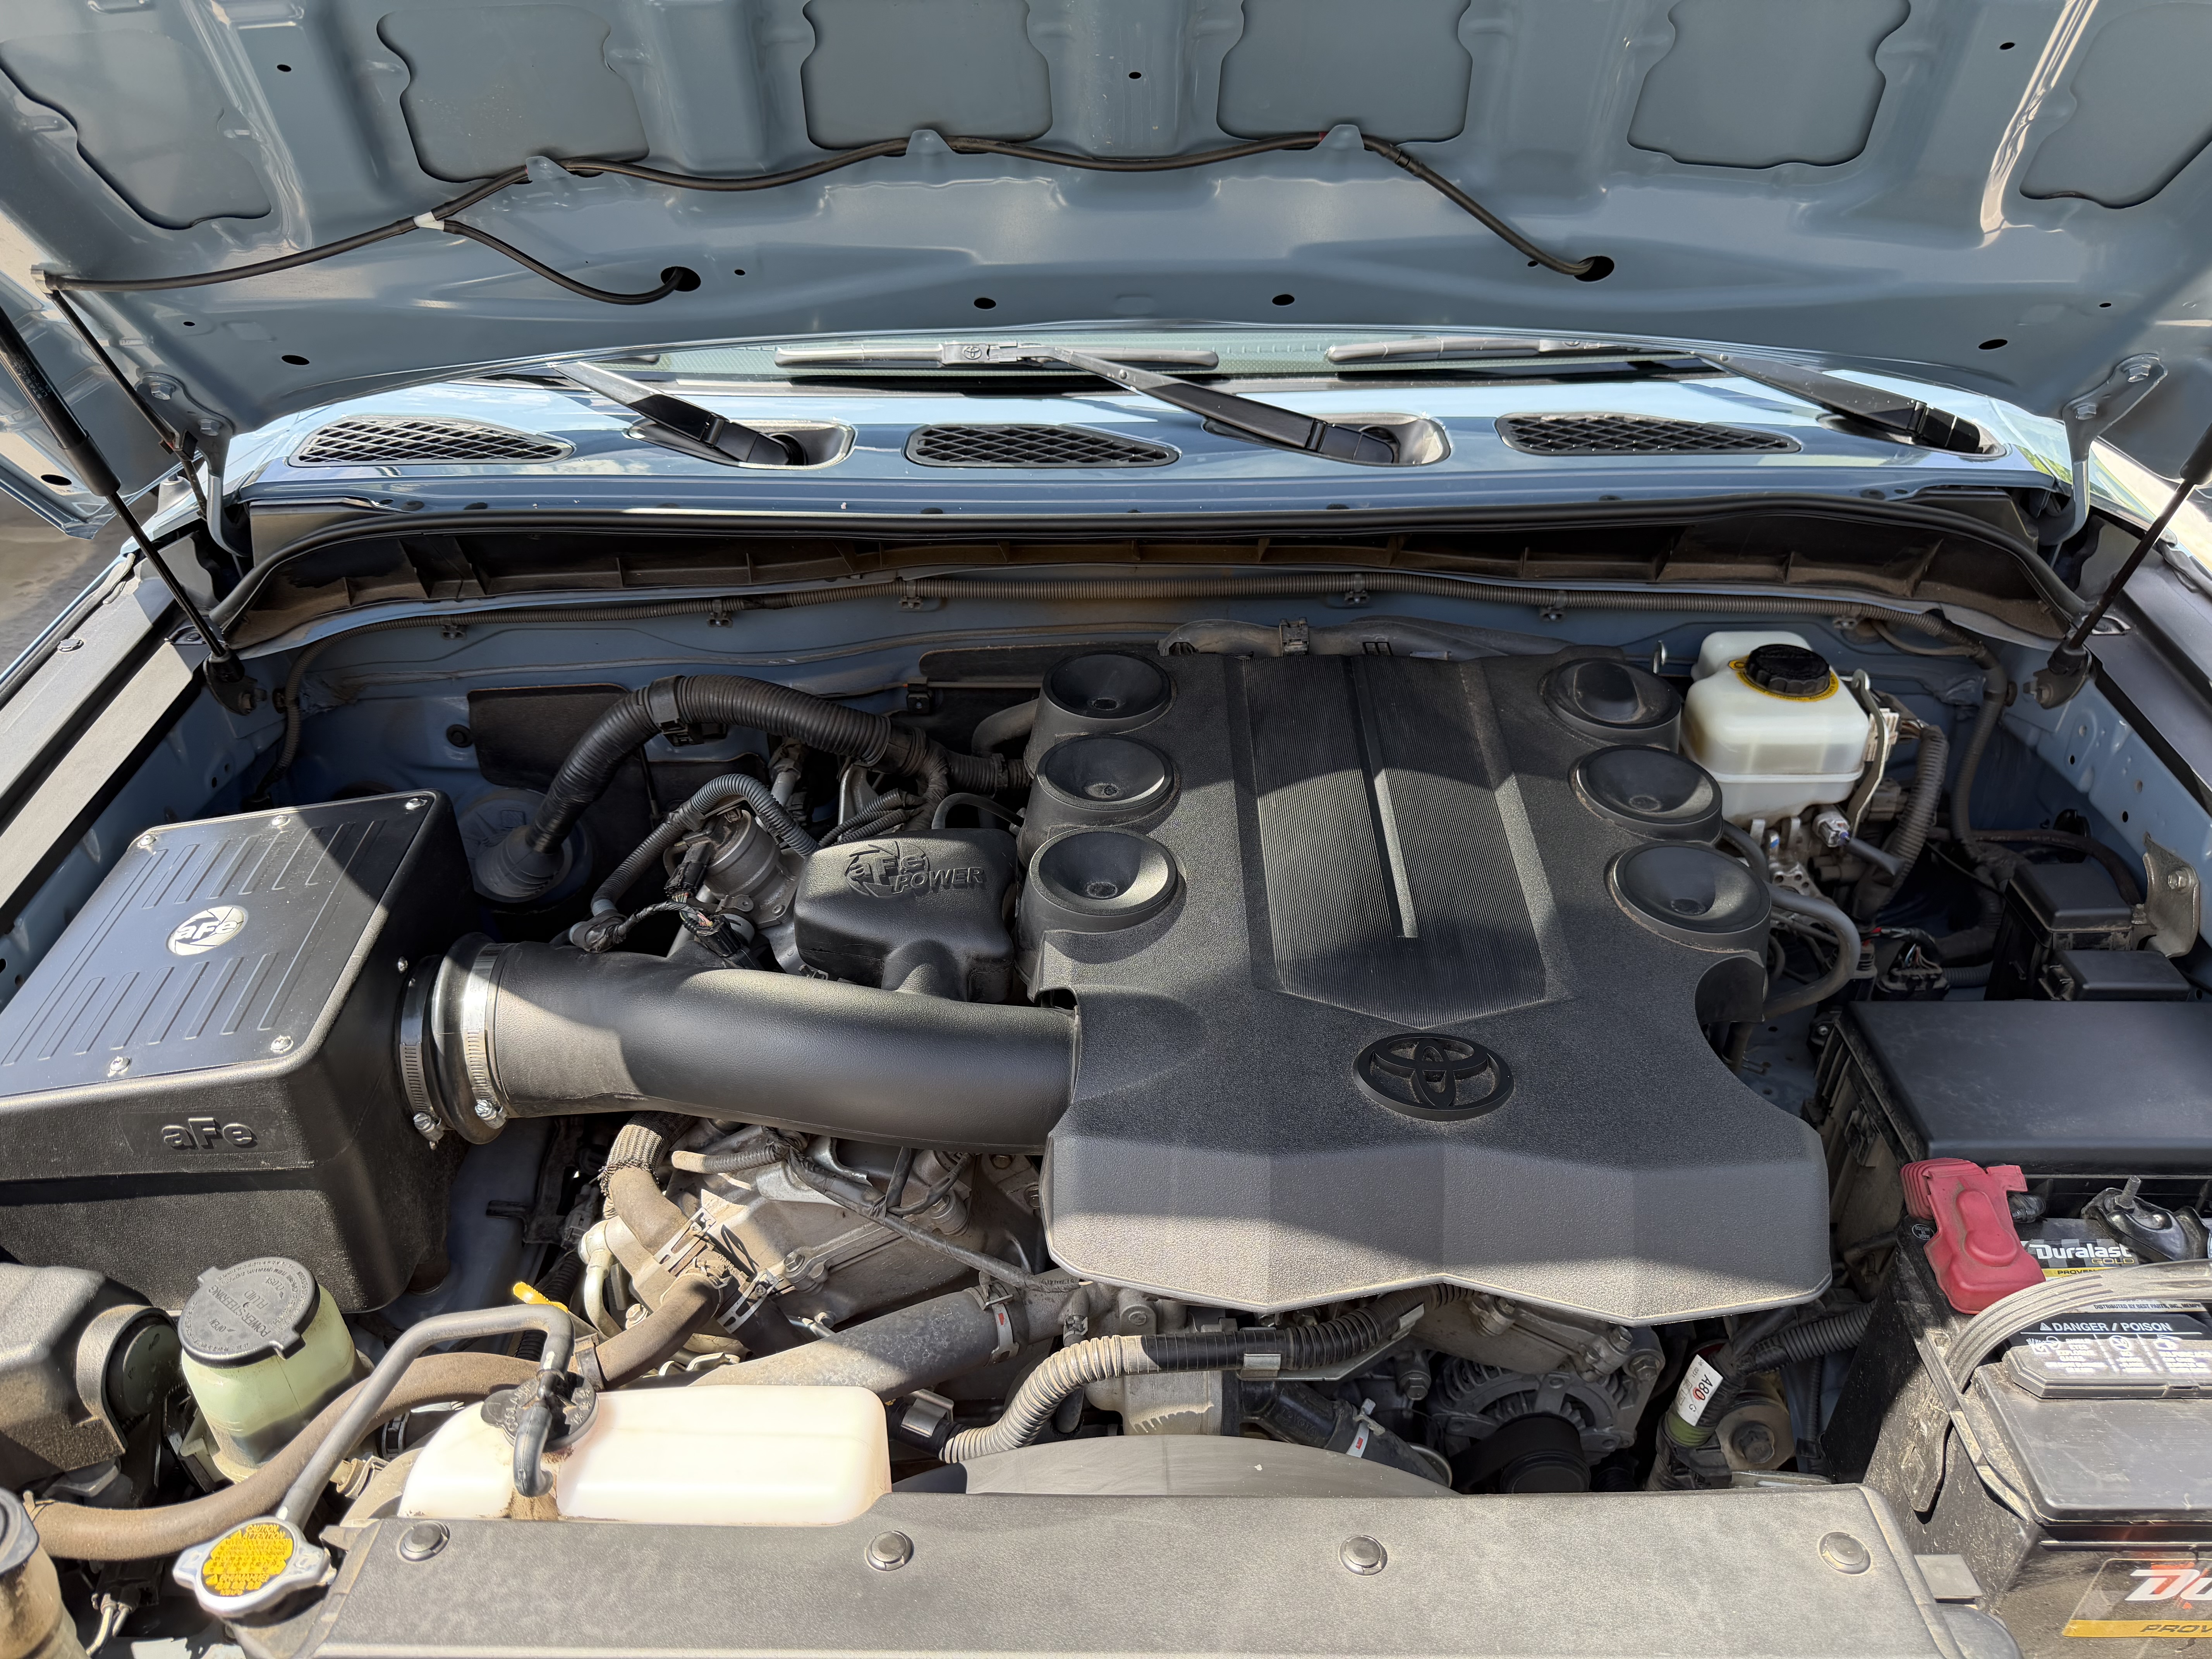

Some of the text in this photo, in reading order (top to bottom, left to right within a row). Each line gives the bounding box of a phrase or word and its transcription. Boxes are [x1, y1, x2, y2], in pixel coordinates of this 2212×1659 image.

[892, 867, 985, 893] POWER
[175, 920, 238, 939] aFe
[161, 1117, 252, 1146] aFe
[2029, 1243, 2132, 1259] Duralast
[208, 1285, 247, 1317] STEERING
[244, 1290, 269, 1310] FLUID
[209, 1318, 227, 1333] OPEN
[241, 1312, 271, 1338] POWER
[2052, 1322, 2173, 1331] DANGER / POISON
[1695, 1374, 1713, 1401] A80
[1689, 1403, 1697, 1412] G
[242, 1530, 286, 1539] ATTENTION
[246, 1524, 280, 1533] CAUTION
